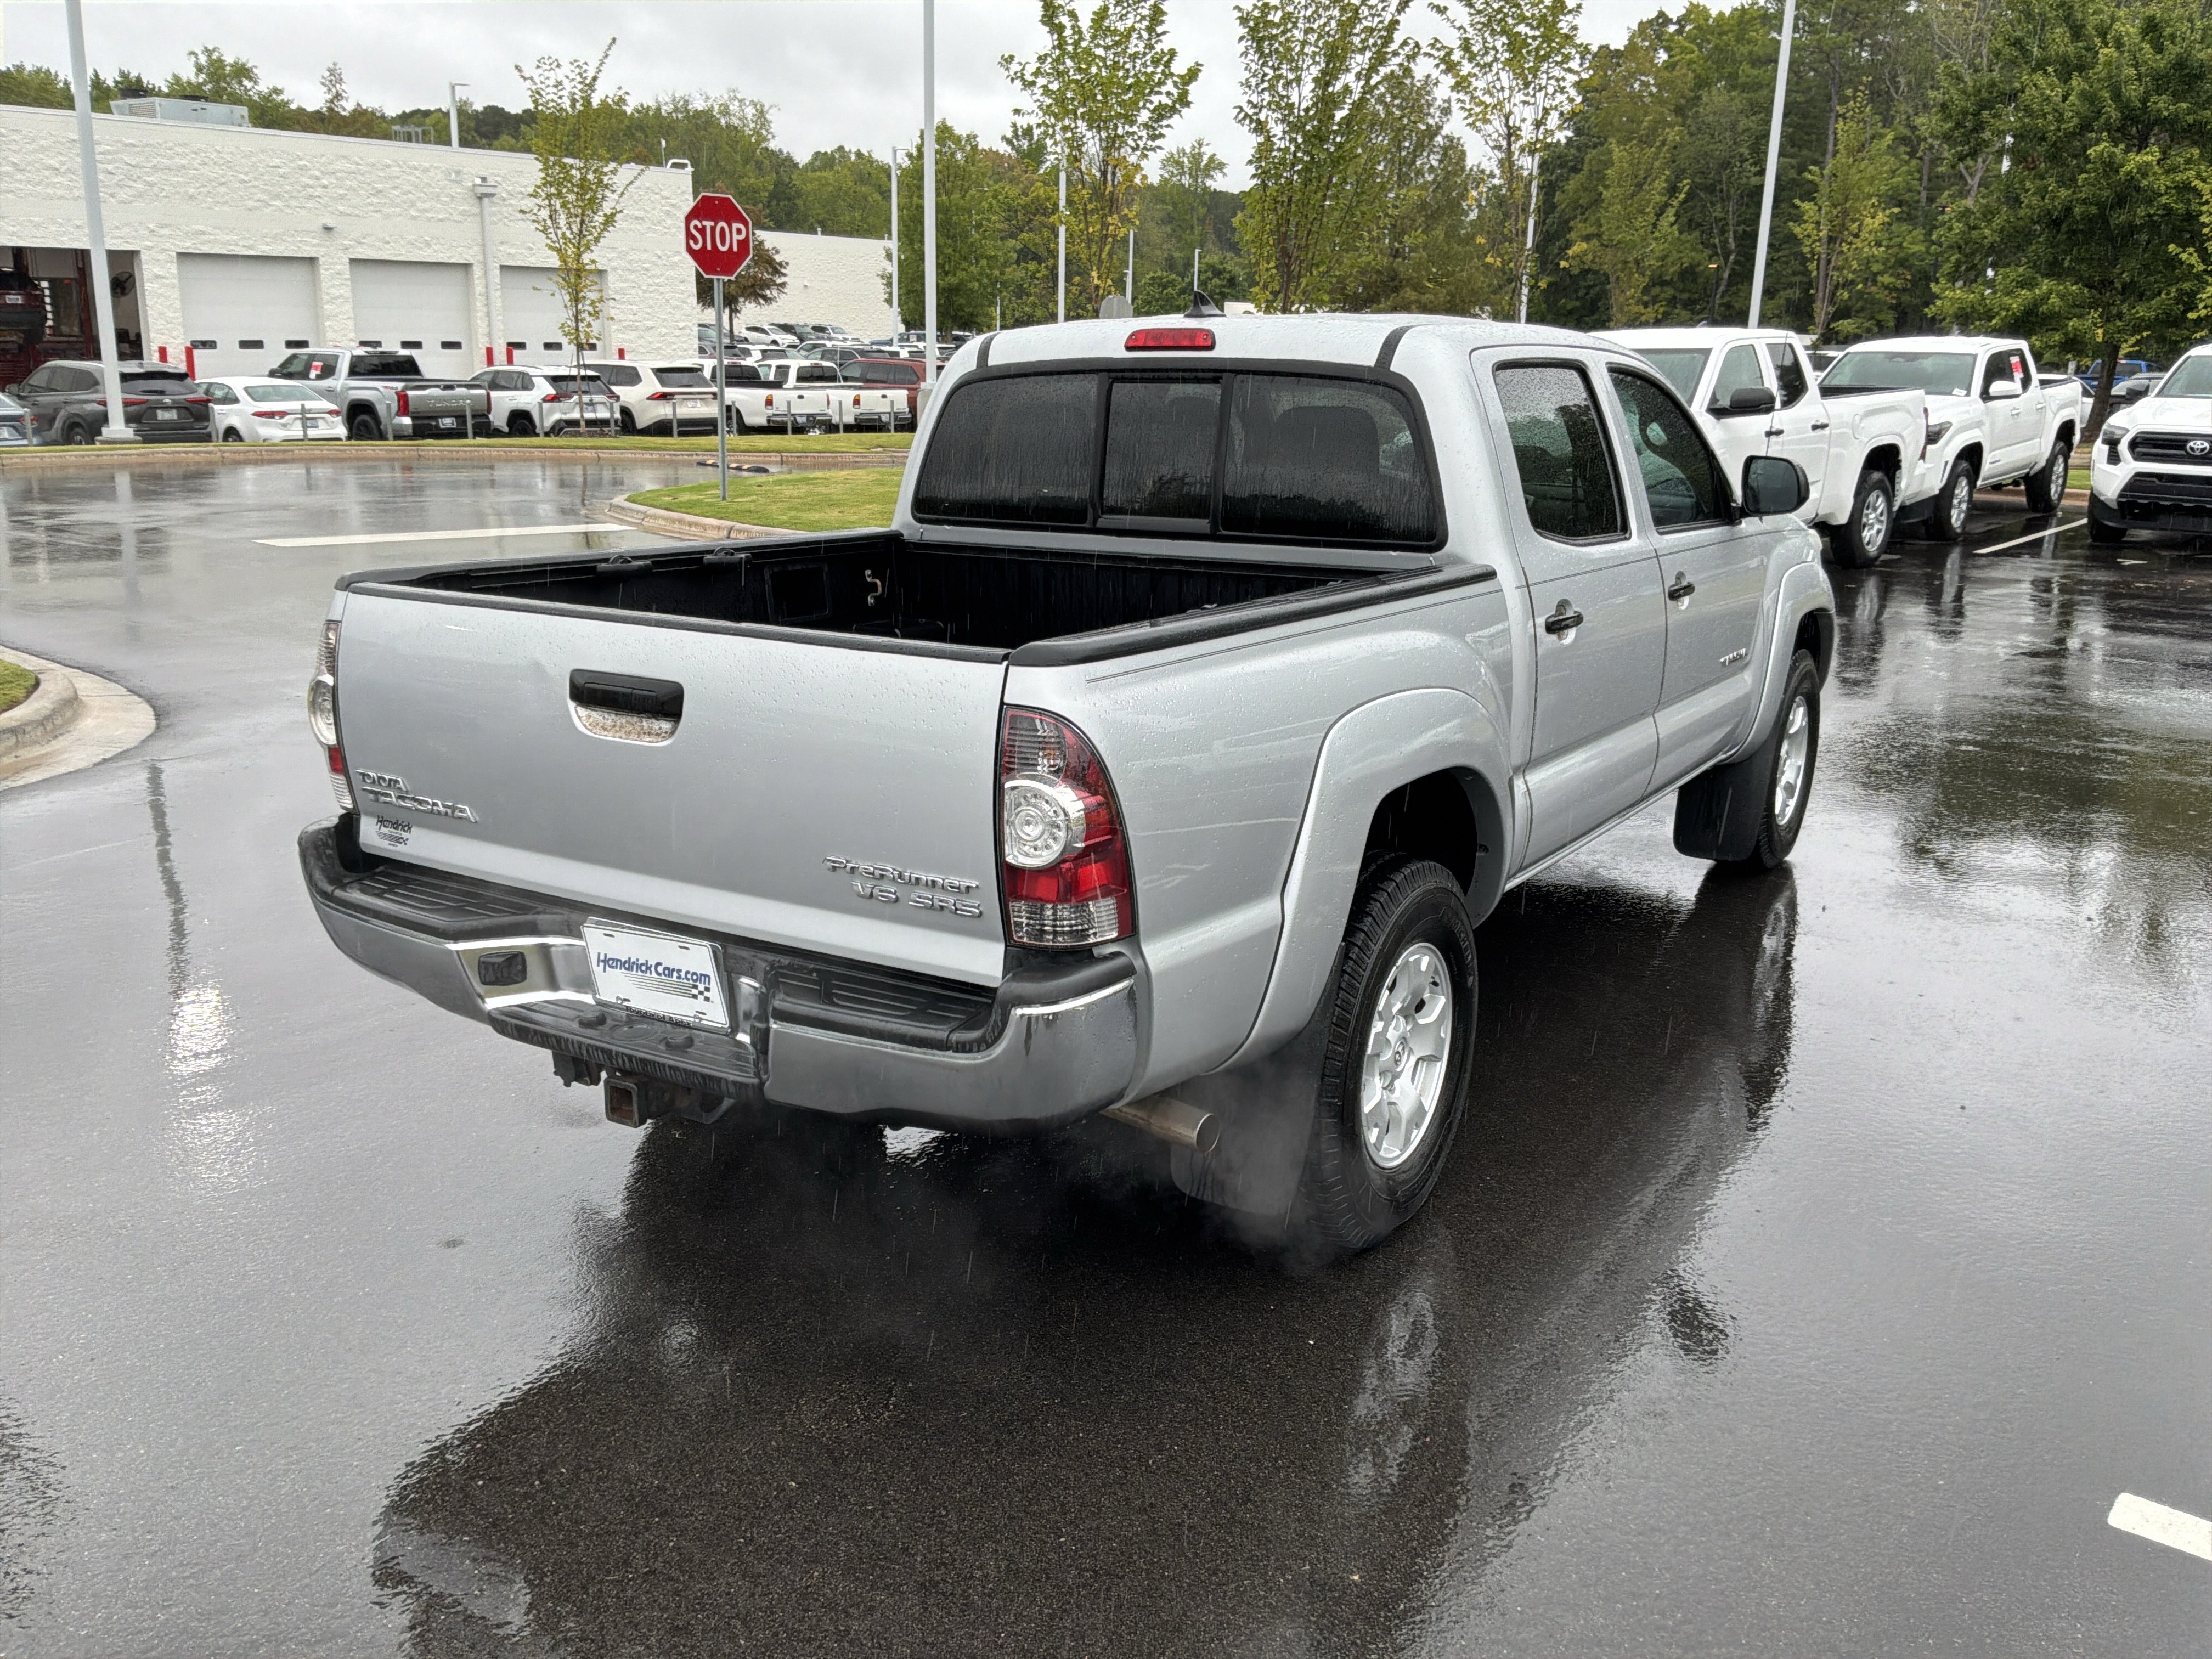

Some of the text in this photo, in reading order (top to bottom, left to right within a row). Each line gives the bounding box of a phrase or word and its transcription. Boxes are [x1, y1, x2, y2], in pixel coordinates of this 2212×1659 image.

[689, 219, 747, 252] STOP
[356, 769, 409, 793] TOYOTA
[362, 787, 478, 823] TACOMA
[376, 815, 413, 834] Hendrick
[822, 855, 980, 894] PreRunner
[851, 880, 983, 918] V6 SR5
[626, 1006, 654, 1018] Toyota
[668, 1016, 692, 1026] Apex
